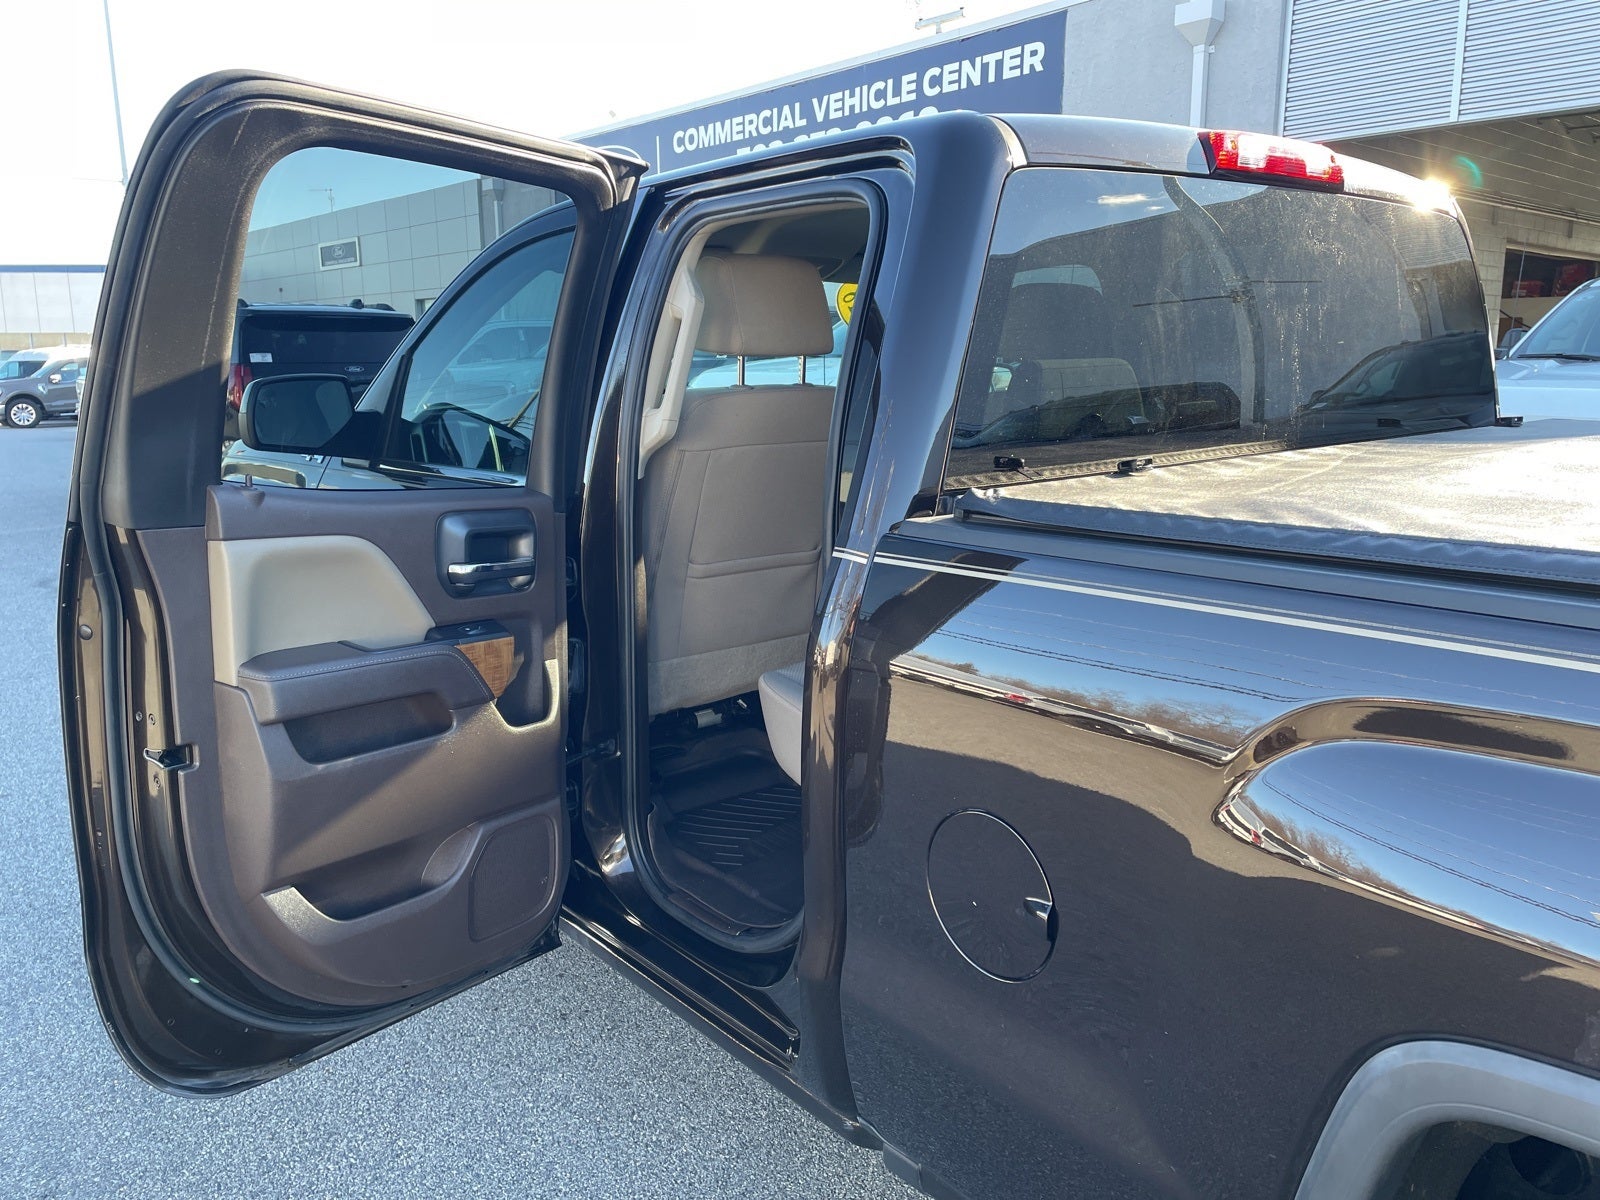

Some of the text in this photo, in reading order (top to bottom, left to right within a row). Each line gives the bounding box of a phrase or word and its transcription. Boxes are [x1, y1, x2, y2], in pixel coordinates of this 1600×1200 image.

[673, 102, 807, 154] COMMERCIAL
[812, 72, 917, 123] VEHICLE
[922, 41, 1045, 97] CENTER
